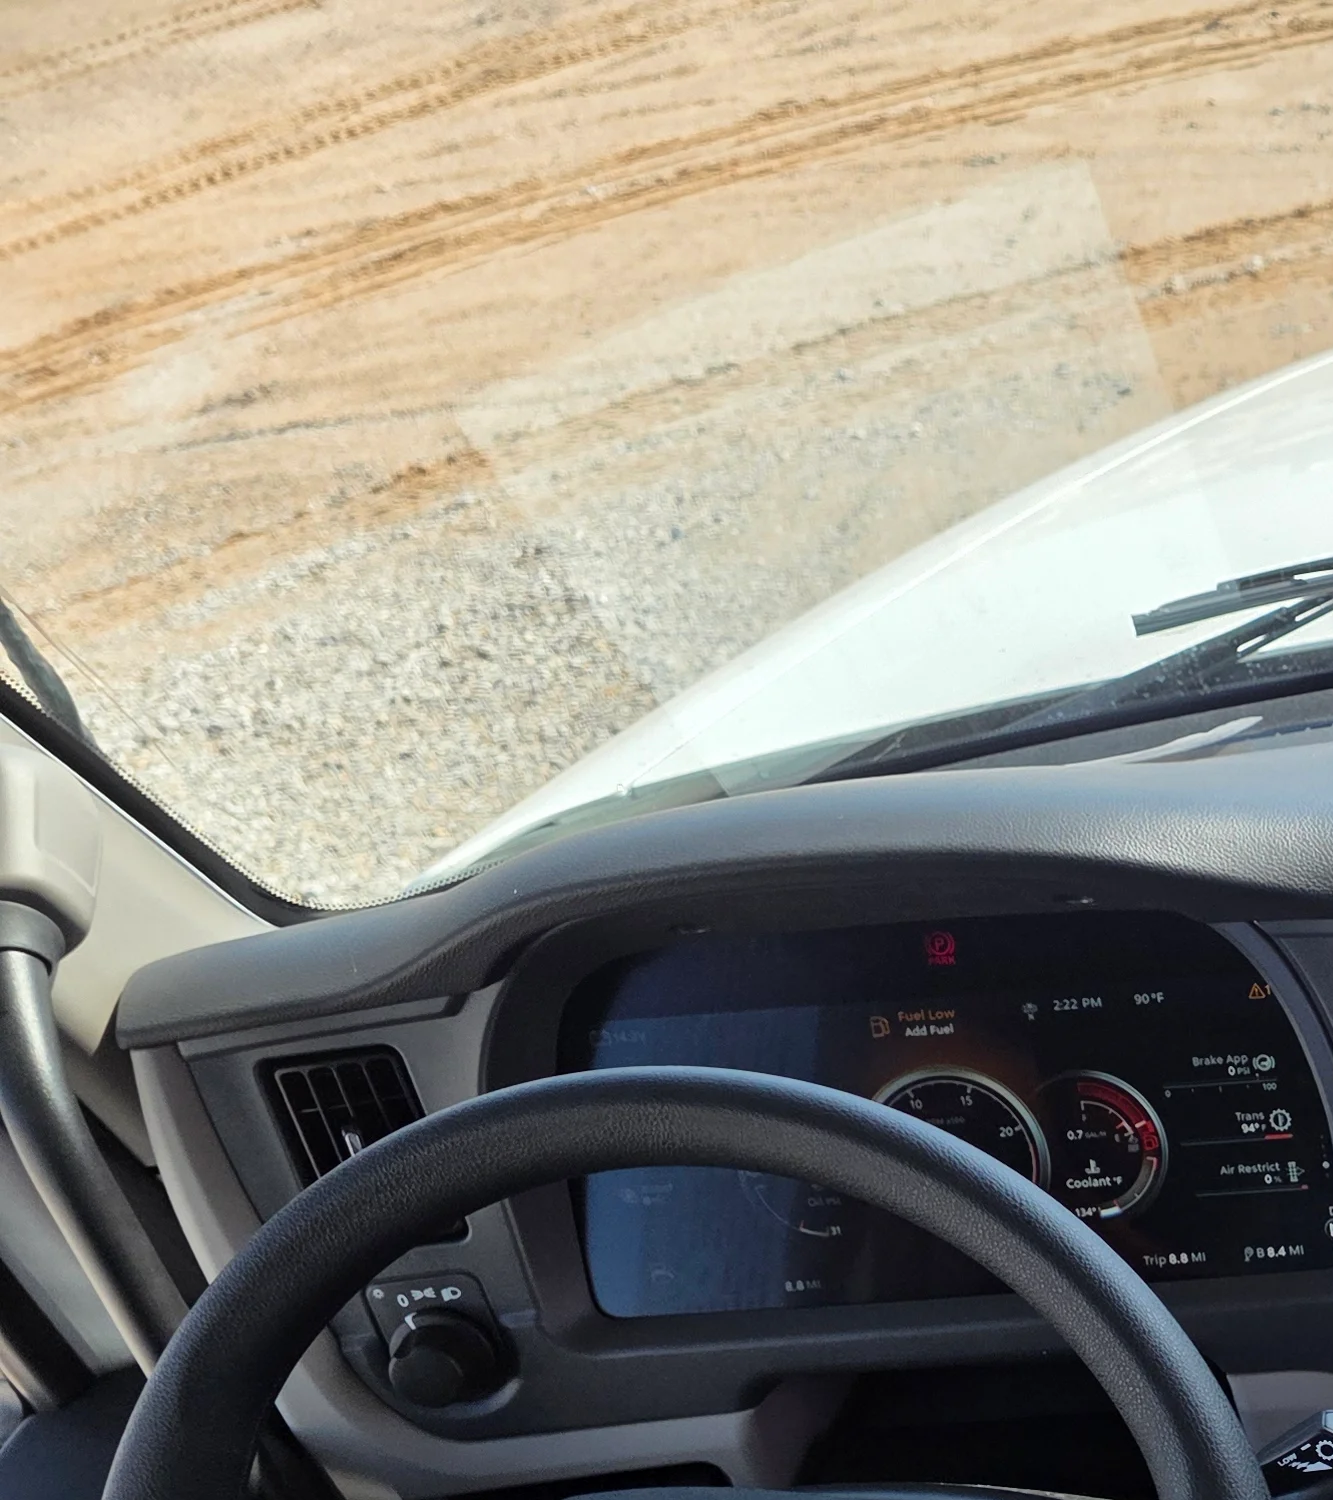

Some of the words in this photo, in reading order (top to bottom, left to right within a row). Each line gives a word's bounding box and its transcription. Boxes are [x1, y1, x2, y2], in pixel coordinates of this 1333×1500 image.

[1053, 999, 1078, 1011] 2:22
[1082, 997, 1102, 1008] PM
[898, 1009, 925, 1022] Fuel
[929, 1010, 955, 1020] Low
[905, 1025, 927, 1037] Add
[930, 1023, 954, 1035] Fuel
[1192, 1056, 1223, 1067] Brake
[1226, 1054, 1248, 1066] App
[1228, 1066, 1236, 1076] 0
[1263, 1083, 1277, 1091] 100
[909, 1099, 923, 1110] 10
[960, 1096, 973, 1106] 15
[1236, 1111, 1265, 1122] Trans
[999, 1126, 1013, 1137] 20
[1067, 1129, 1083, 1140] 0.7
[1220, 1164, 1234, 1175] Air
[1238, 1162, 1280, 1173] Restrict
[1066, 1176, 1111, 1189] Coolant
[1264, 1174, 1272, 1184] 0
[1267, 1247, 1287, 1258] 8.4
[1289, 1245, 1304, 1256] MI
[1143, 1254, 1166, 1268] Trip
[1168, 1253, 1188, 1265] 8.8
[1191, 1252, 1206, 1262] MI
[1277, 1452, 1298, 1467] LOW
